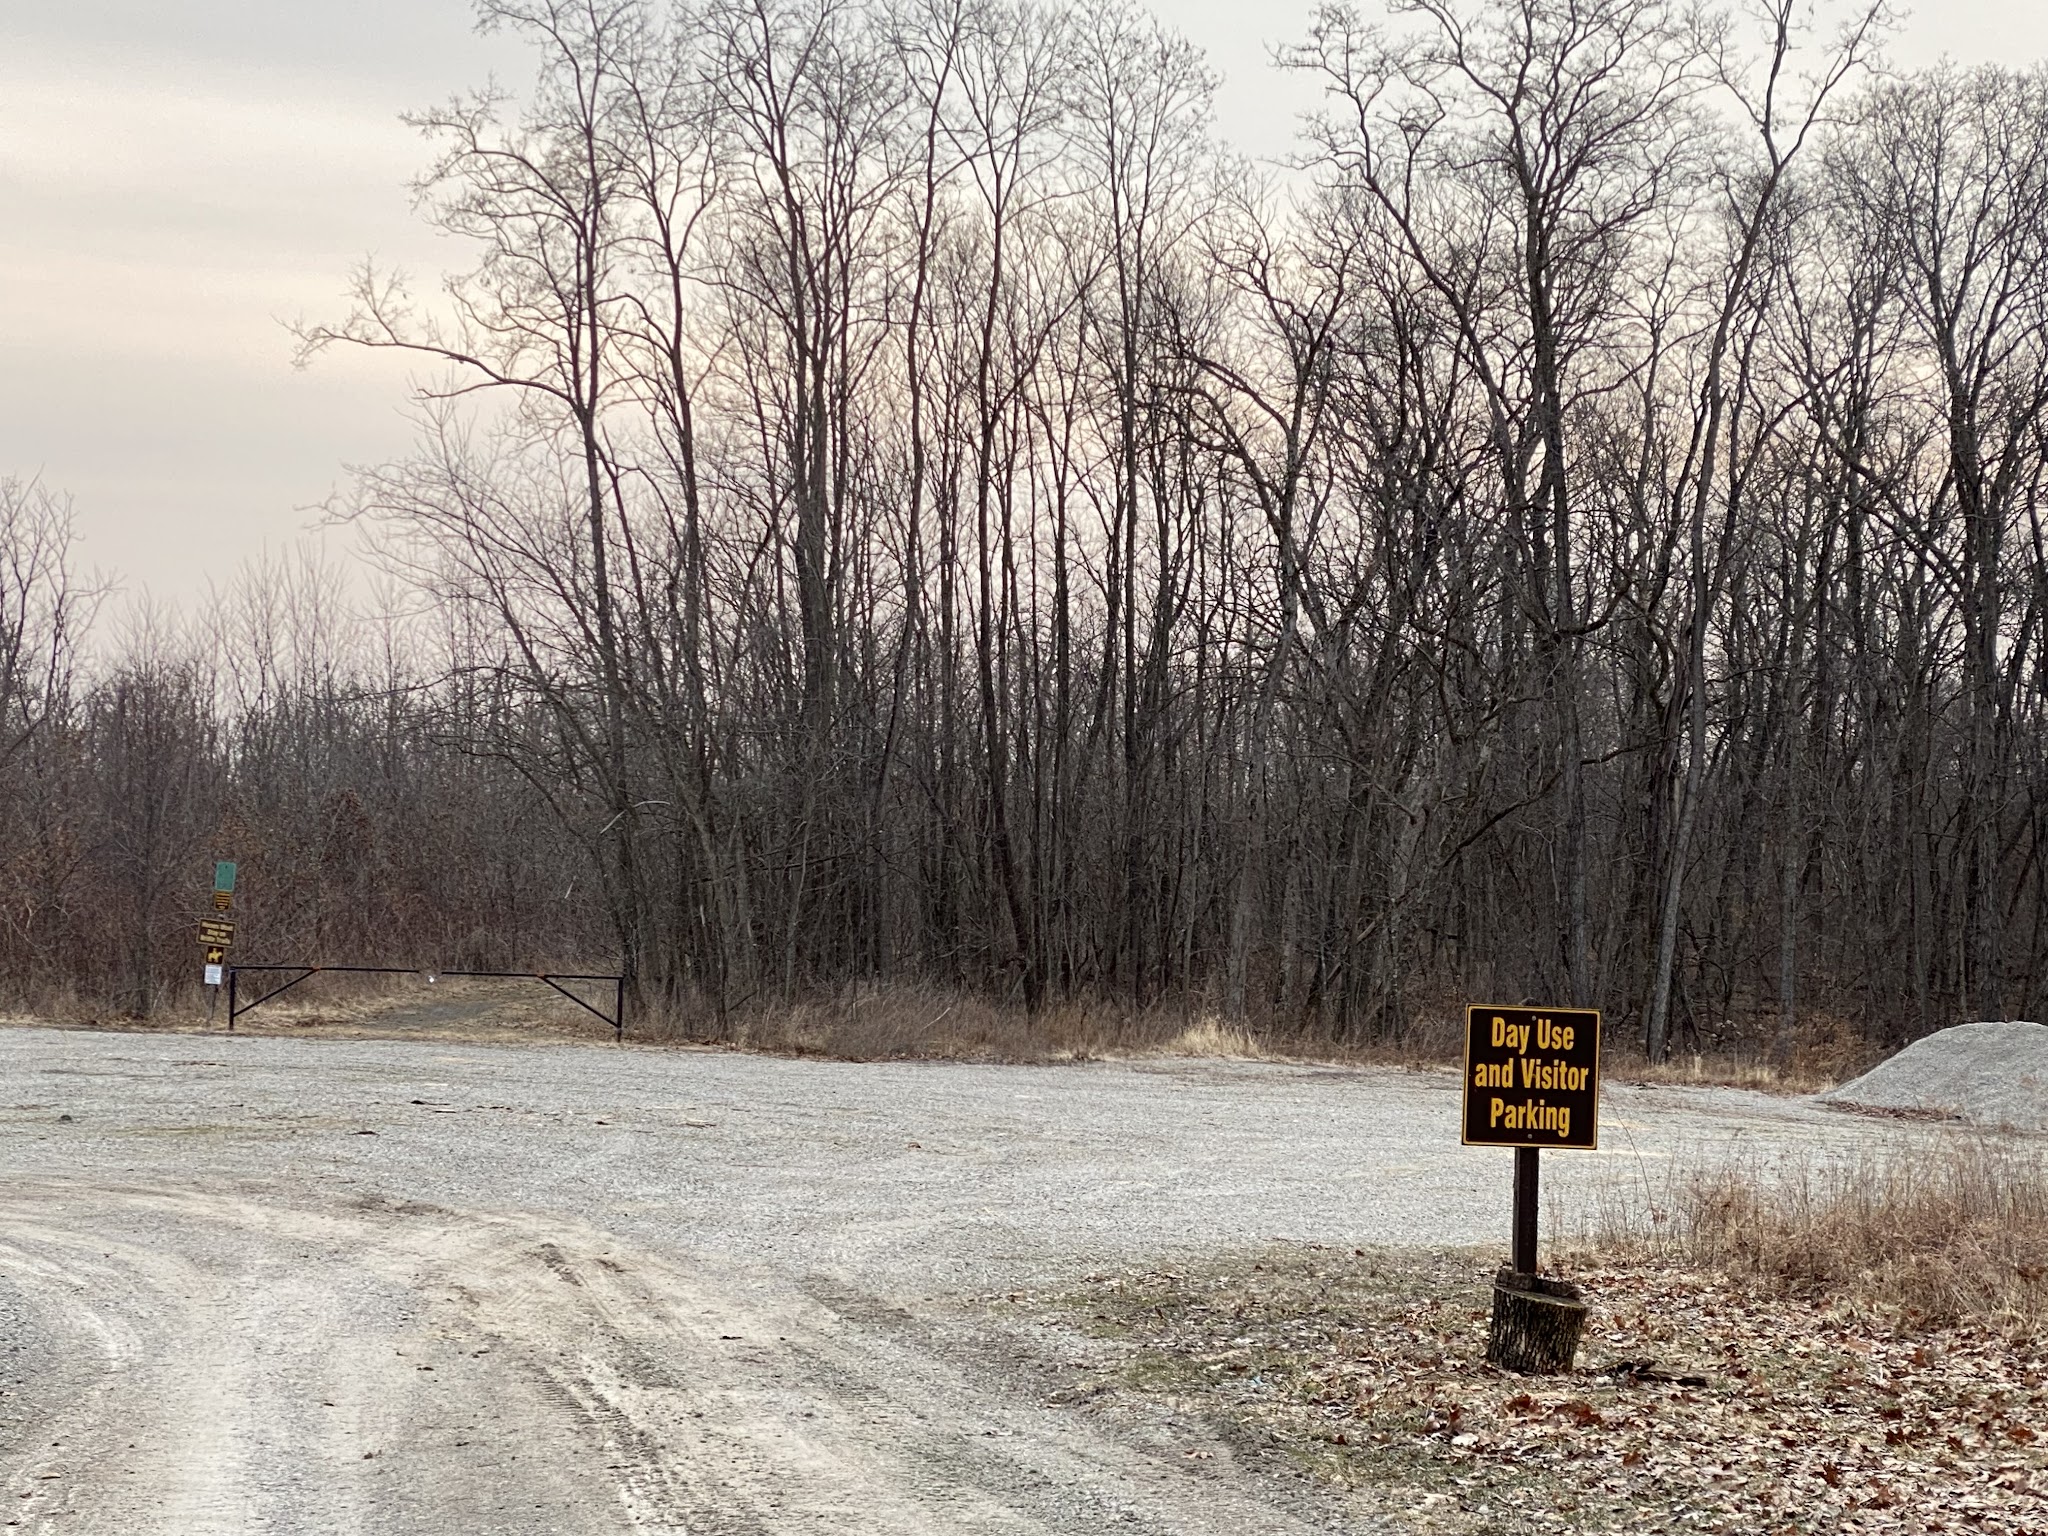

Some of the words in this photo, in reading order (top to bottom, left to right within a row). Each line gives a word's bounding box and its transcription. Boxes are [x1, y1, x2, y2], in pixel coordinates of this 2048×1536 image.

[1492, 1017, 1530, 1055] Day
[1537, 1019, 1575, 1050] Use
[1475, 1057, 1514, 1088] and
[1521, 1058, 1589, 1091] Visitor
[1490, 1097, 1570, 1138] Parking
